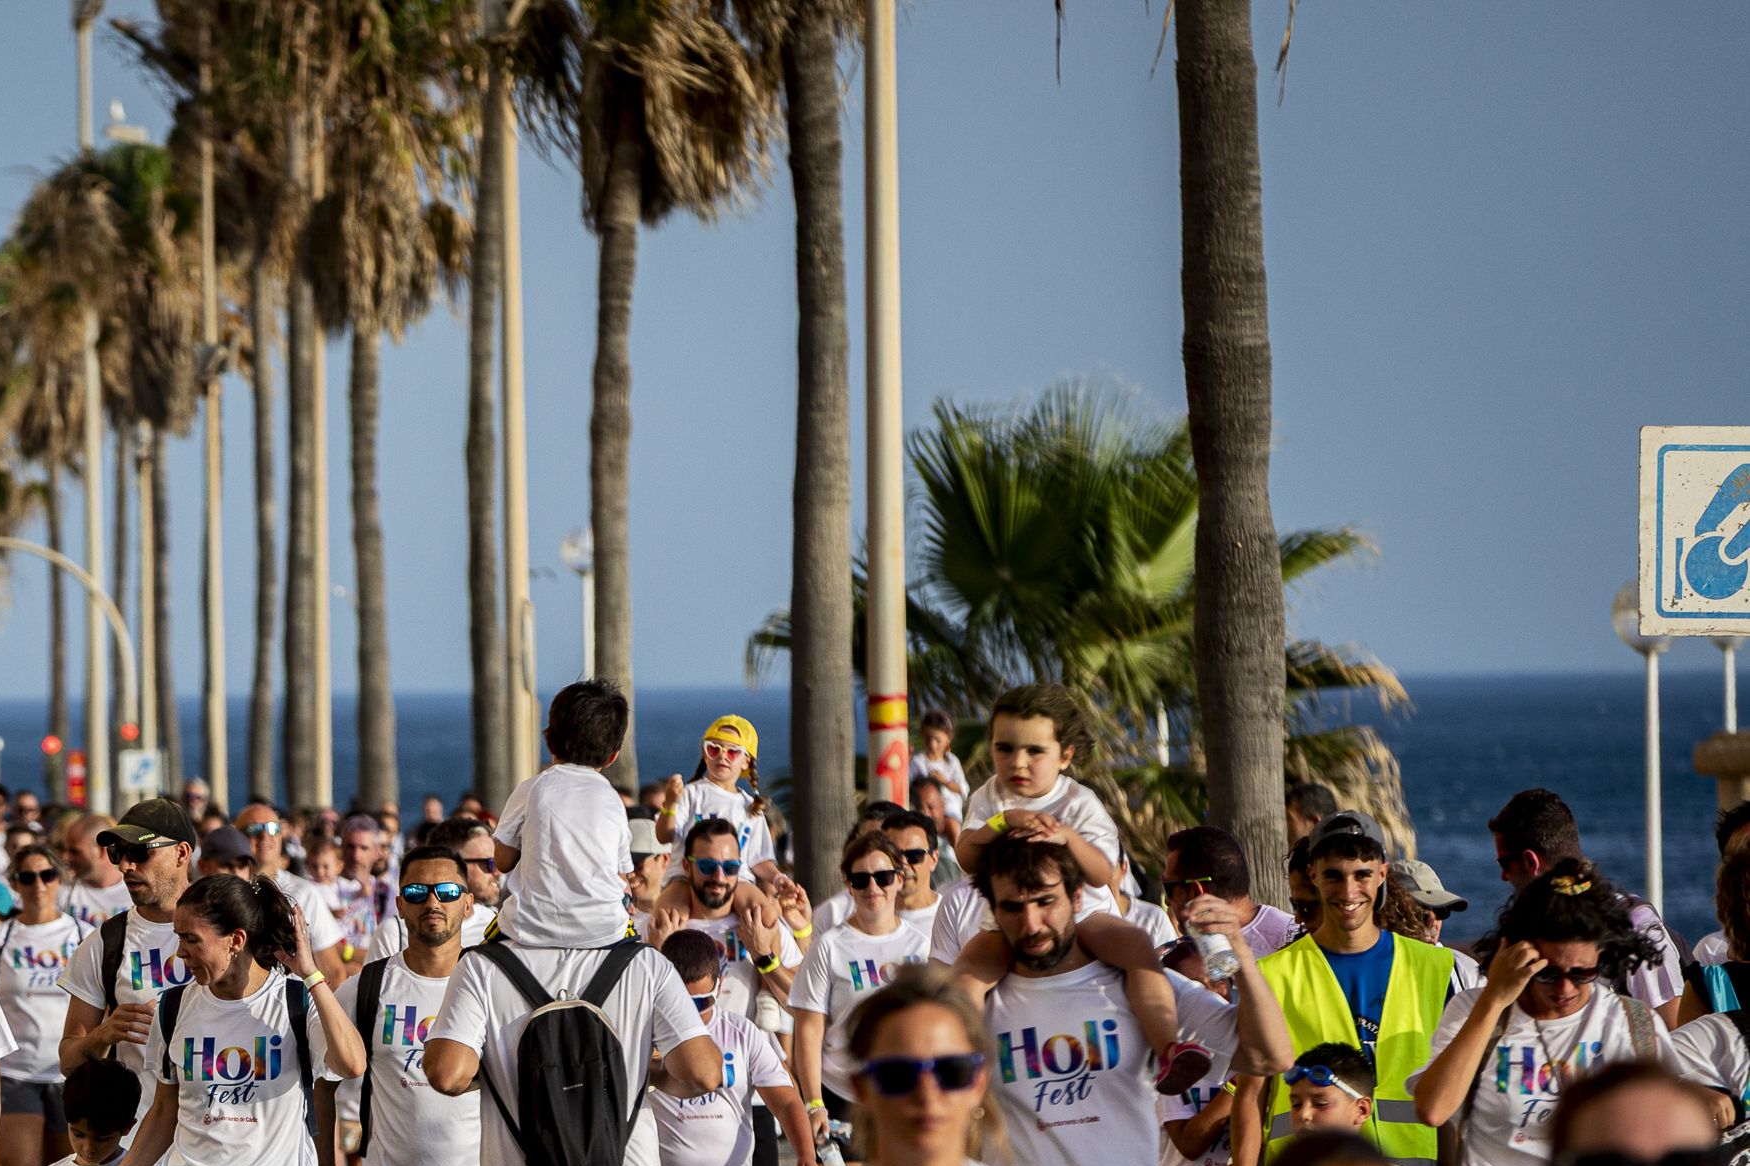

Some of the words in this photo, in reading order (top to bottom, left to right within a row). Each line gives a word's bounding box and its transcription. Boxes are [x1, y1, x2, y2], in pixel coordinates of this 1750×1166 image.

[183, 1034, 282, 1081] Holi
[997, 1019, 1121, 1084] Holi
[207, 1080, 260, 1108] Fest
[1034, 1072, 1097, 1113] Fest
